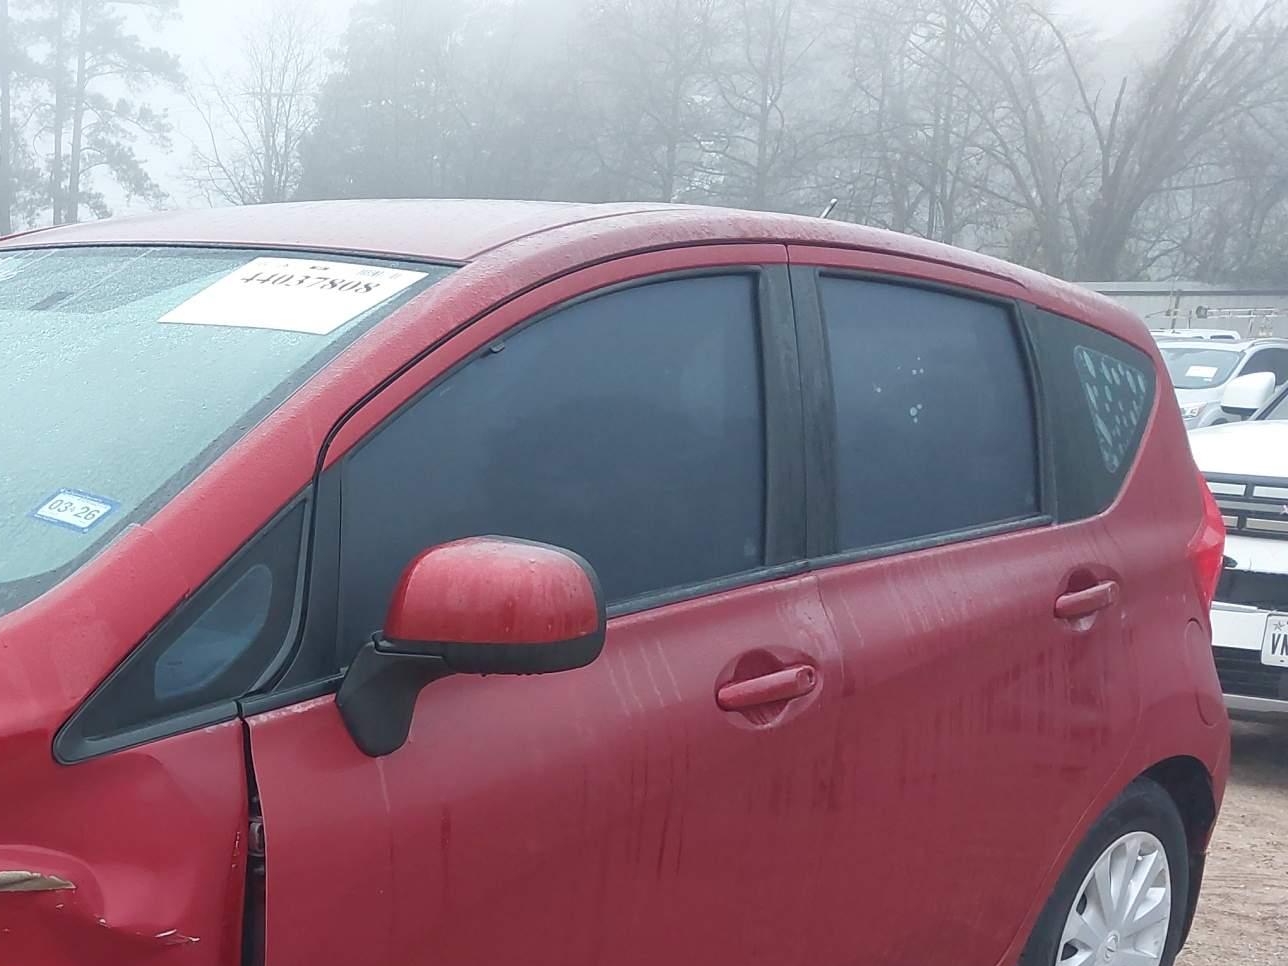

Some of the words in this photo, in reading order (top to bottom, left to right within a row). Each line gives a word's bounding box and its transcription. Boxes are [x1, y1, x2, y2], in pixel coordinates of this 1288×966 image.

[240, 271, 381, 294] 44037808
[47, 499, 73, 513] 03
[73, 505, 100, 521] 26
